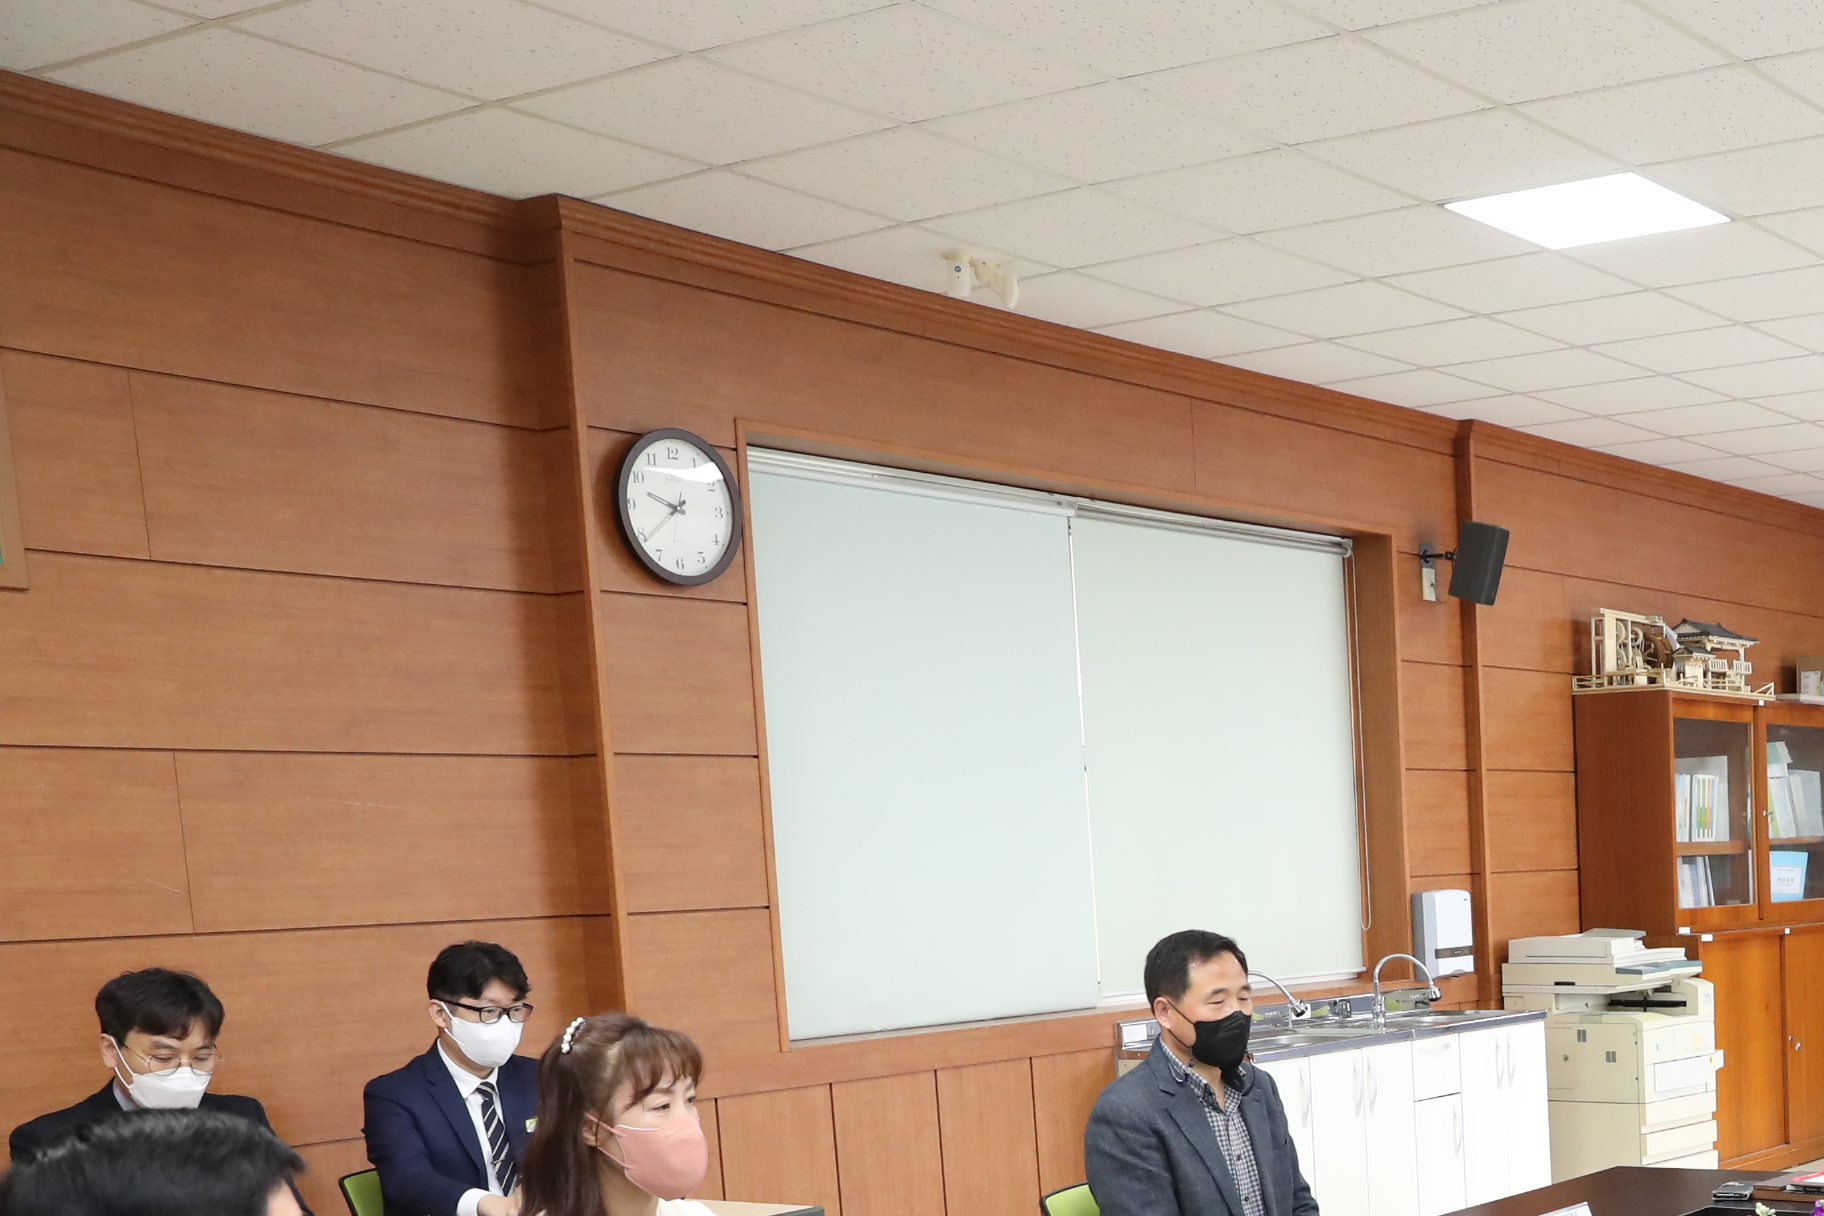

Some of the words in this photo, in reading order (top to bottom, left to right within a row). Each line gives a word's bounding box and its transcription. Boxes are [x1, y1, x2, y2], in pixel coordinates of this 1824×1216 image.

[646, 452, 657, 466] 11
[666, 447, 679, 460] 12
[632, 470, 645, 484] 10
[627, 497, 636, 511] 9
[714, 506, 723, 519] 3
[711, 533, 720, 546] 4
[655, 548, 663, 561] 7
[697, 551, 706, 564] 5
[675, 558, 685, 570] 6
